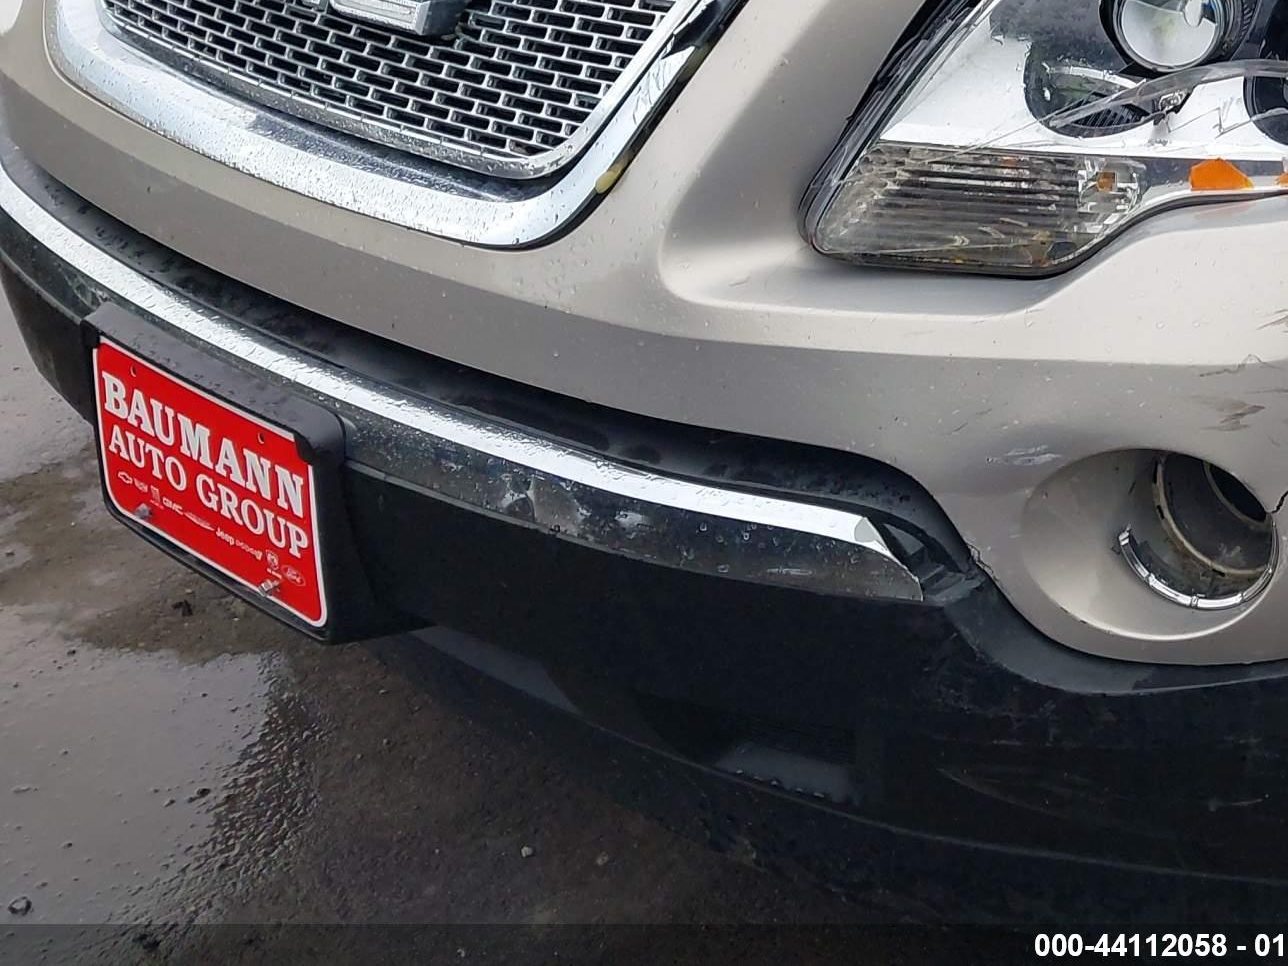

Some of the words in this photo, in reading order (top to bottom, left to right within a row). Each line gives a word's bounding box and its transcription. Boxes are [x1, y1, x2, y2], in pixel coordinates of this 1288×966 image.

[101, 371, 304, 519] BAUMANN
[108, 424, 187, 492] AUTO
[196, 473, 309, 559] GROUP
